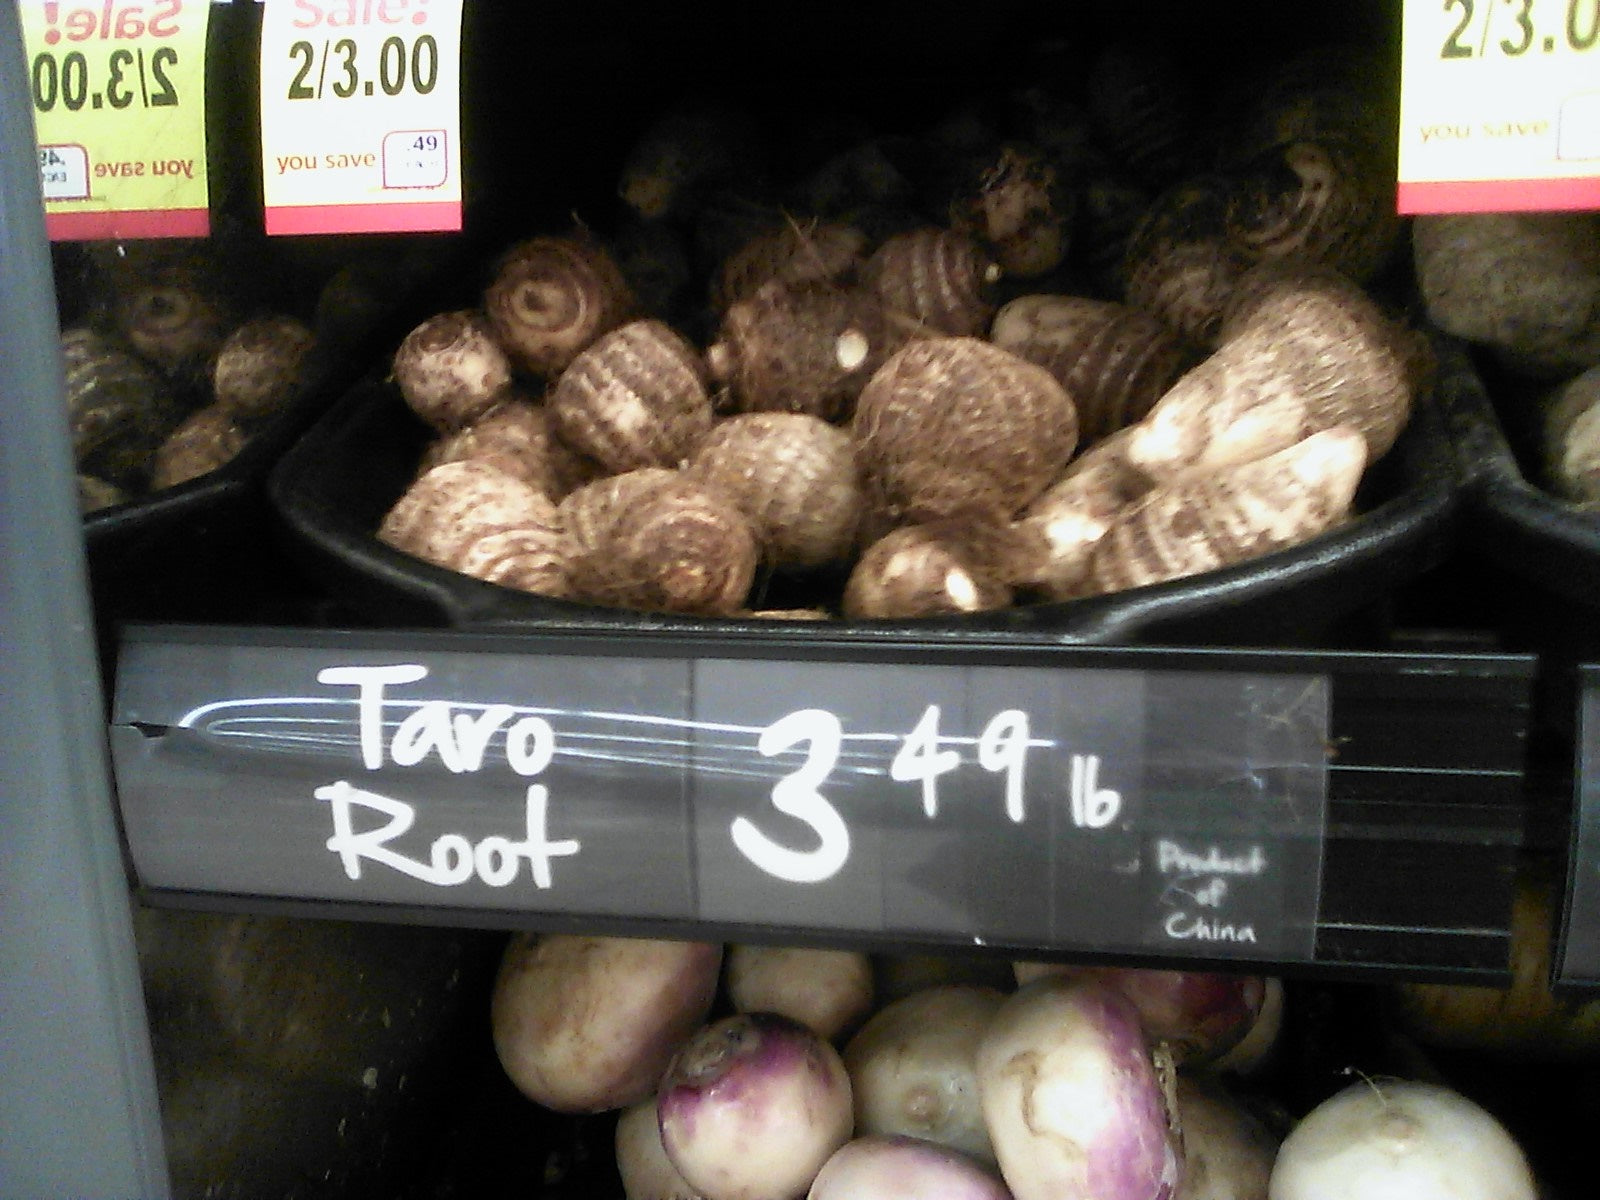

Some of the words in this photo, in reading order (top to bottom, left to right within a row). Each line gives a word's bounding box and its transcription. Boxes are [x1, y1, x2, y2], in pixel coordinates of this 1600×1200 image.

[288, 34, 438, 99] 2/3.00
[406, 134, 438, 151] .49
[1420, 124, 1470, 143] you
[1482, 119, 1549, 137] save
[277, 155, 317, 175] you
[326, 152, 376, 169] save
[317, 664, 556, 776] Taro
[1071, 755, 1122, 828] lb
[314, 781, 581, 888] Root
[1165, 911, 1257, 944] China
